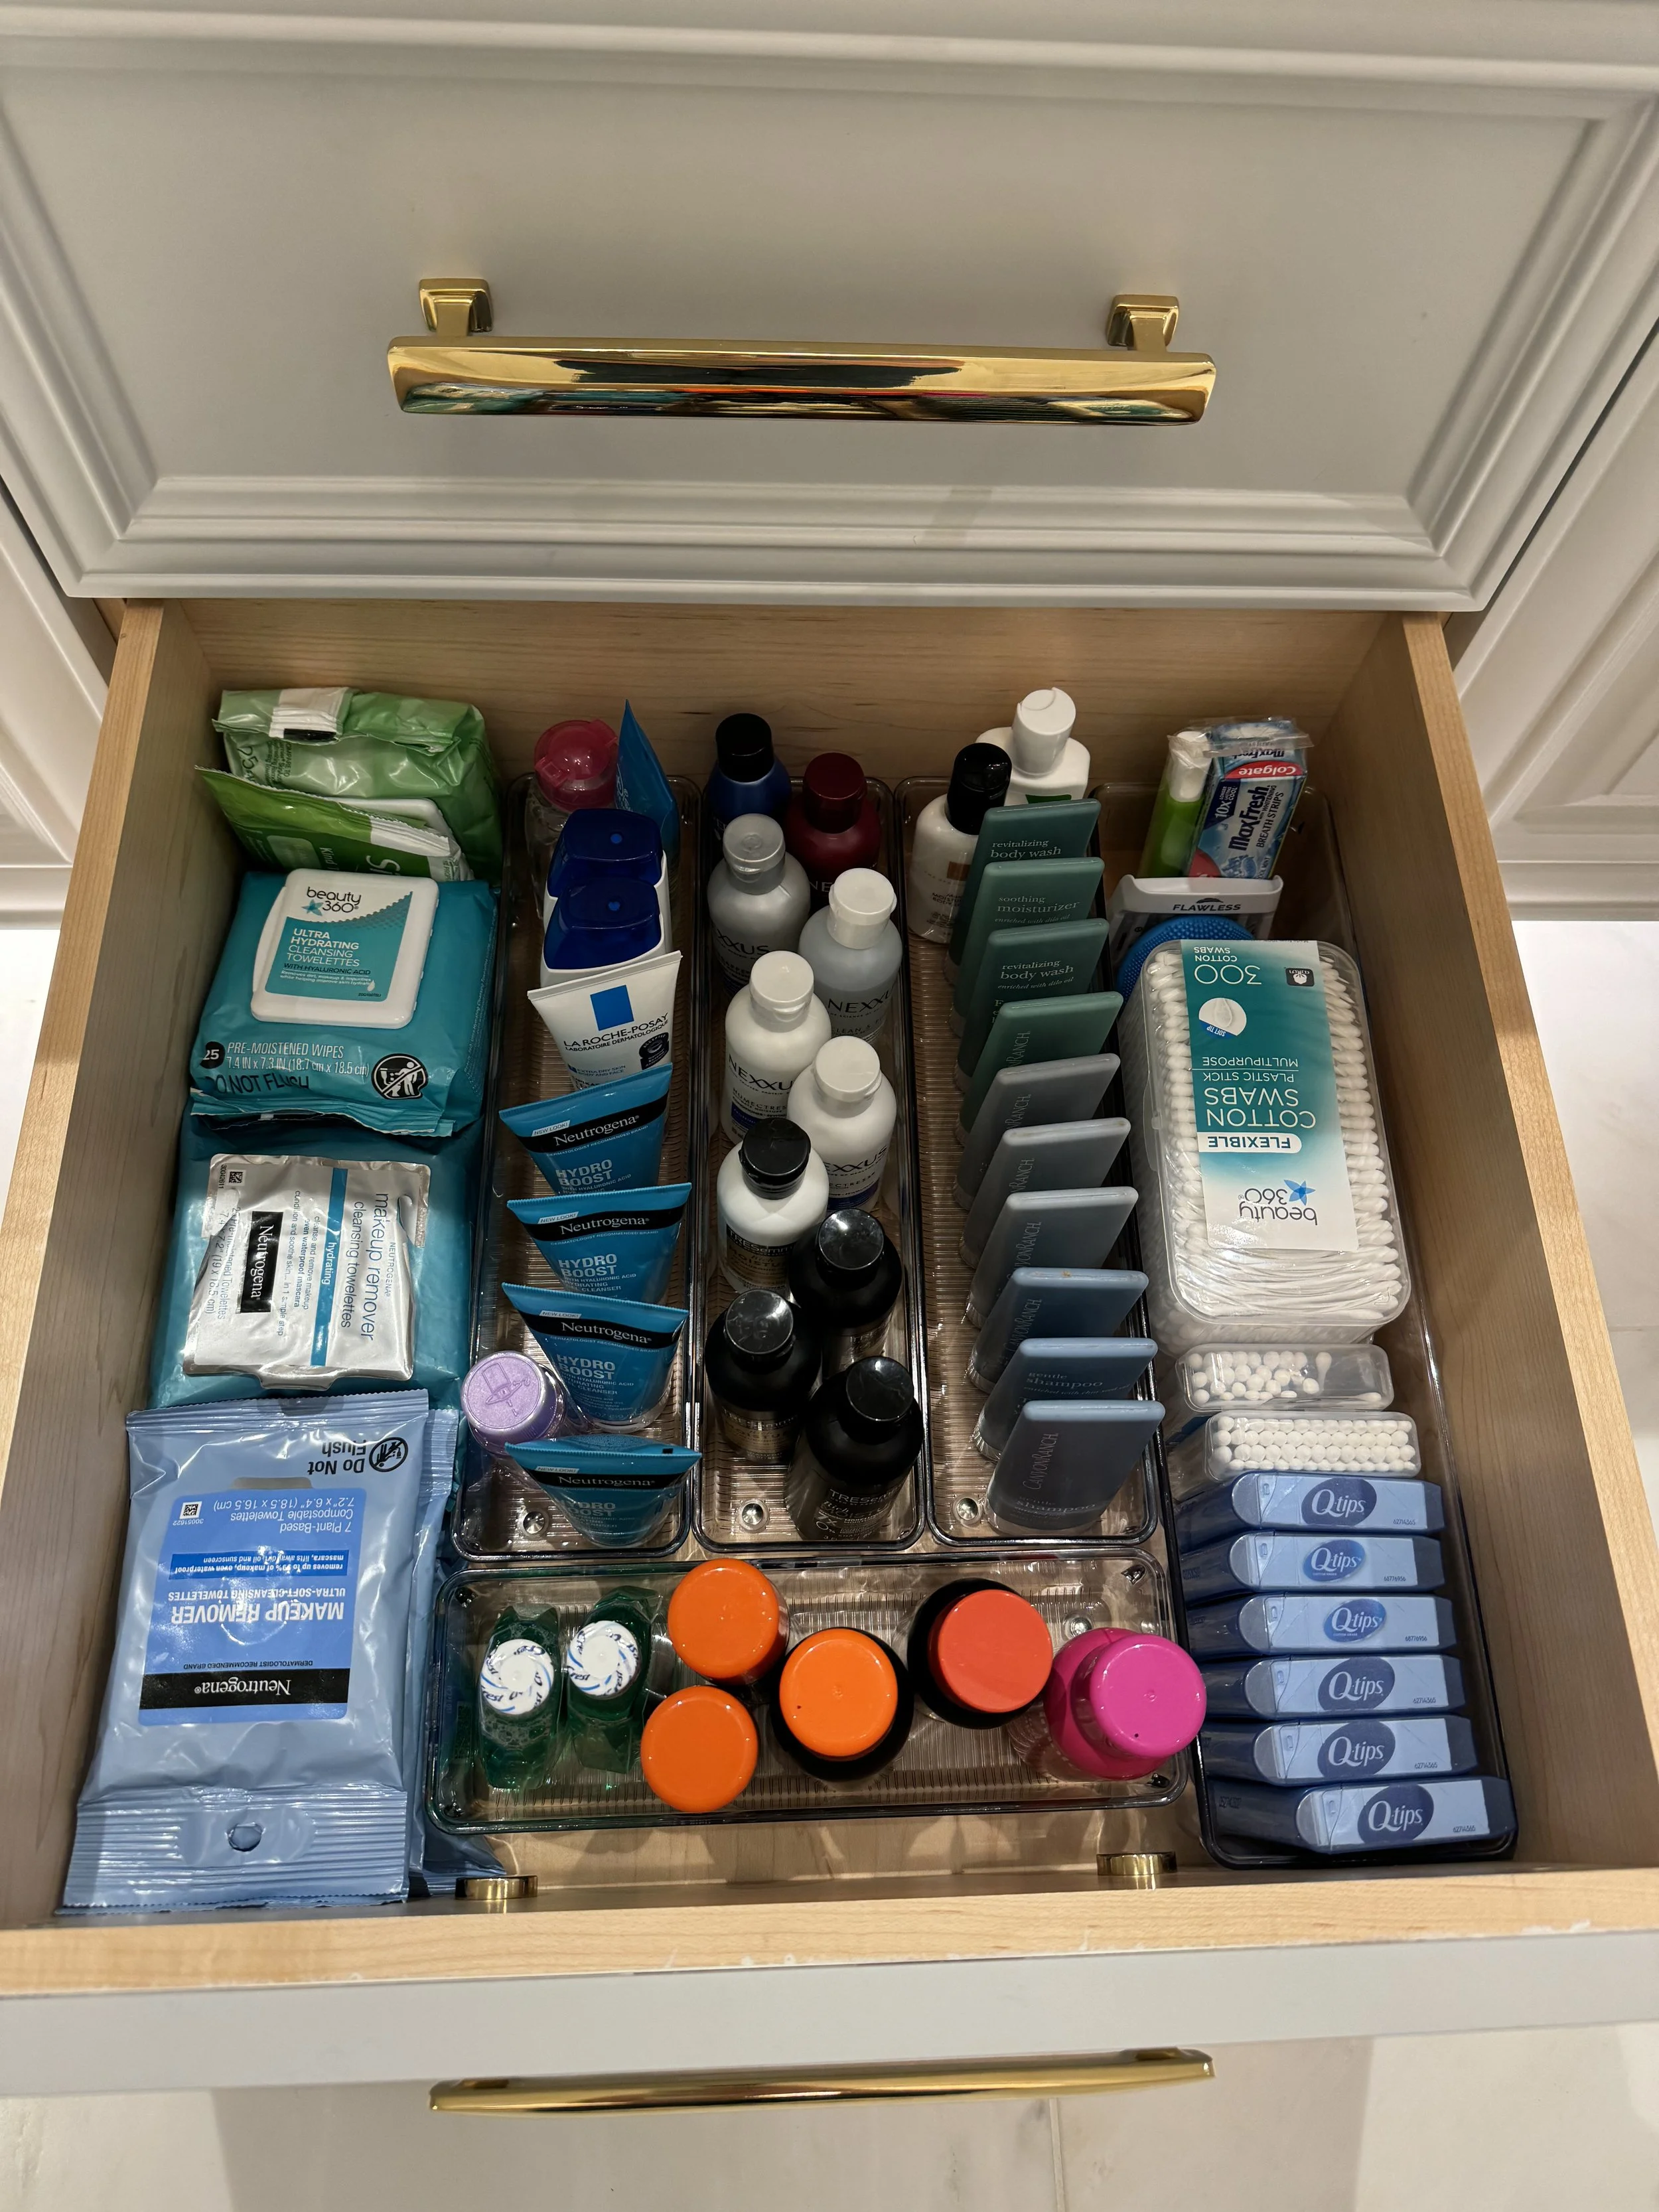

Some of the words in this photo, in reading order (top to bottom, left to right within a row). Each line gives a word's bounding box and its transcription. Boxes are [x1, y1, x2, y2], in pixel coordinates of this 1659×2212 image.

[1239, 765, 1296, 775] Colgate
[1228, 785, 1270, 851] MaxFresh
[1256, 819, 1273, 848] BREATH
[1267, 792, 1284, 818] STRIPS
[991, 850, 1025, 861] body
[1029, 847, 1061, 857] wash
[307, 887, 362, 905] beauty
[997, 902, 1080, 913] moisturizer
[293, 928, 330, 939] ULTRA
[289, 945, 354, 958] CLEANSING
[291, 937, 360, 950] HYDRATING
[287, 953, 360, 967] TOWELETTES
[1002, 960, 1061, 970] revitalizing
[305, 966, 352, 974] HYALURONIC
[1001, 972, 1037, 981] body
[1041, 965, 1074, 978] wash
[1194, 964, 1262, 984] 300
[565, 1041, 611, 1052] LABORATOIRE
[613, 1019, 668, 1045] DERMATOLOGIQUE
[582, 1012, 668, 1046] ROCHE-POSAY
[228, 1042, 309, 1056] PRE-MOISTENED
[311, 1044, 344, 1059] WIPES
[226, 1057, 240, 1069] 7.4
[242, 1057, 251, 1069] IN
[253, 1061, 258, 1069] x
[261, 1057, 274, 1070] 7.3
[276, 1057, 286, 1071] IN
[287, 1058, 309, 1072] (18.7
[312, 1062, 324, 1072] cm
[326, 1065, 330, 1073] x
[334, 1061, 353, 1074] 18.5
[354, 1064, 370, 1076] cm)
[1202, 1057, 1299, 1067] MULTIPURPOSE
[228, 1074, 261, 1094] NOT
[1203, 1072, 1239, 1081] STICK
[1243, 1072, 1294, 1082] PLASTIC
[1204, 1087, 1299, 1106] SWABS
[1206, 1108, 1316, 1128] COTTON
[549, 1123, 568, 1132] LOOK!
[591, 1133, 630, 1146] RECOMMENDED
[1208, 1136, 1291, 1149] FLEXIBLE
[555, 1159, 613, 1178] HYDRO
[559, 1170, 613, 1187] BOOST
[1239, 1201, 1317, 1225] beauty
[346, 1201, 366, 1258] cleansing
[366, 1193, 390, 1261] makeup
[211, 1254, 223, 1269] (19
[251, 1225, 274, 1299] Neutrogena
[299, 1236, 307, 1274] waterproof
[558, 1254, 617, 1268] HYDRO
[322, 1242, 336, 1285] hydrating
[561, 1265, 617, 1278] BOOST
[218, 1276, 232, 1320] Towelettes
[303, 1282, 313, 1310] makeup
[341, 1263, 360, 1328] towelettes
[204, 1297, 216, 1315] cm)
[361, 1267, 380, 1341] remover
[557, 1354, 616, 1370] HYDRO
[559, 1364, 615, 1380] BOOST
[1027, 1377, 1103, 1389] shampoo
[322, 1439, 367, 1458] Flush
[307, 1459, 337, 1475] Not
[343, 1458, 366, 1473] Do
[214, 1500, 232, 1512] cm)
[235, 1499, 259, 1509] 16.5
[271, 1497, 298, 1509] (18.5
[301, 1499, 323, 1508] 6.4"
[333, 1497, 354, 1507] 7.2"
[230, 1510, 285, 1522] Towelettes
[287, 1509, 354, 1520] Compostable
[279, 1521, 342, 1533] Plant-Based
[345, 1522, 352, 1532] 7
[168, 1590, 229, 1601] TOWELETTES
[171, 1603, 260, 1624] REMOVER
[265, 1601, 344, 1621] MAKEUP
